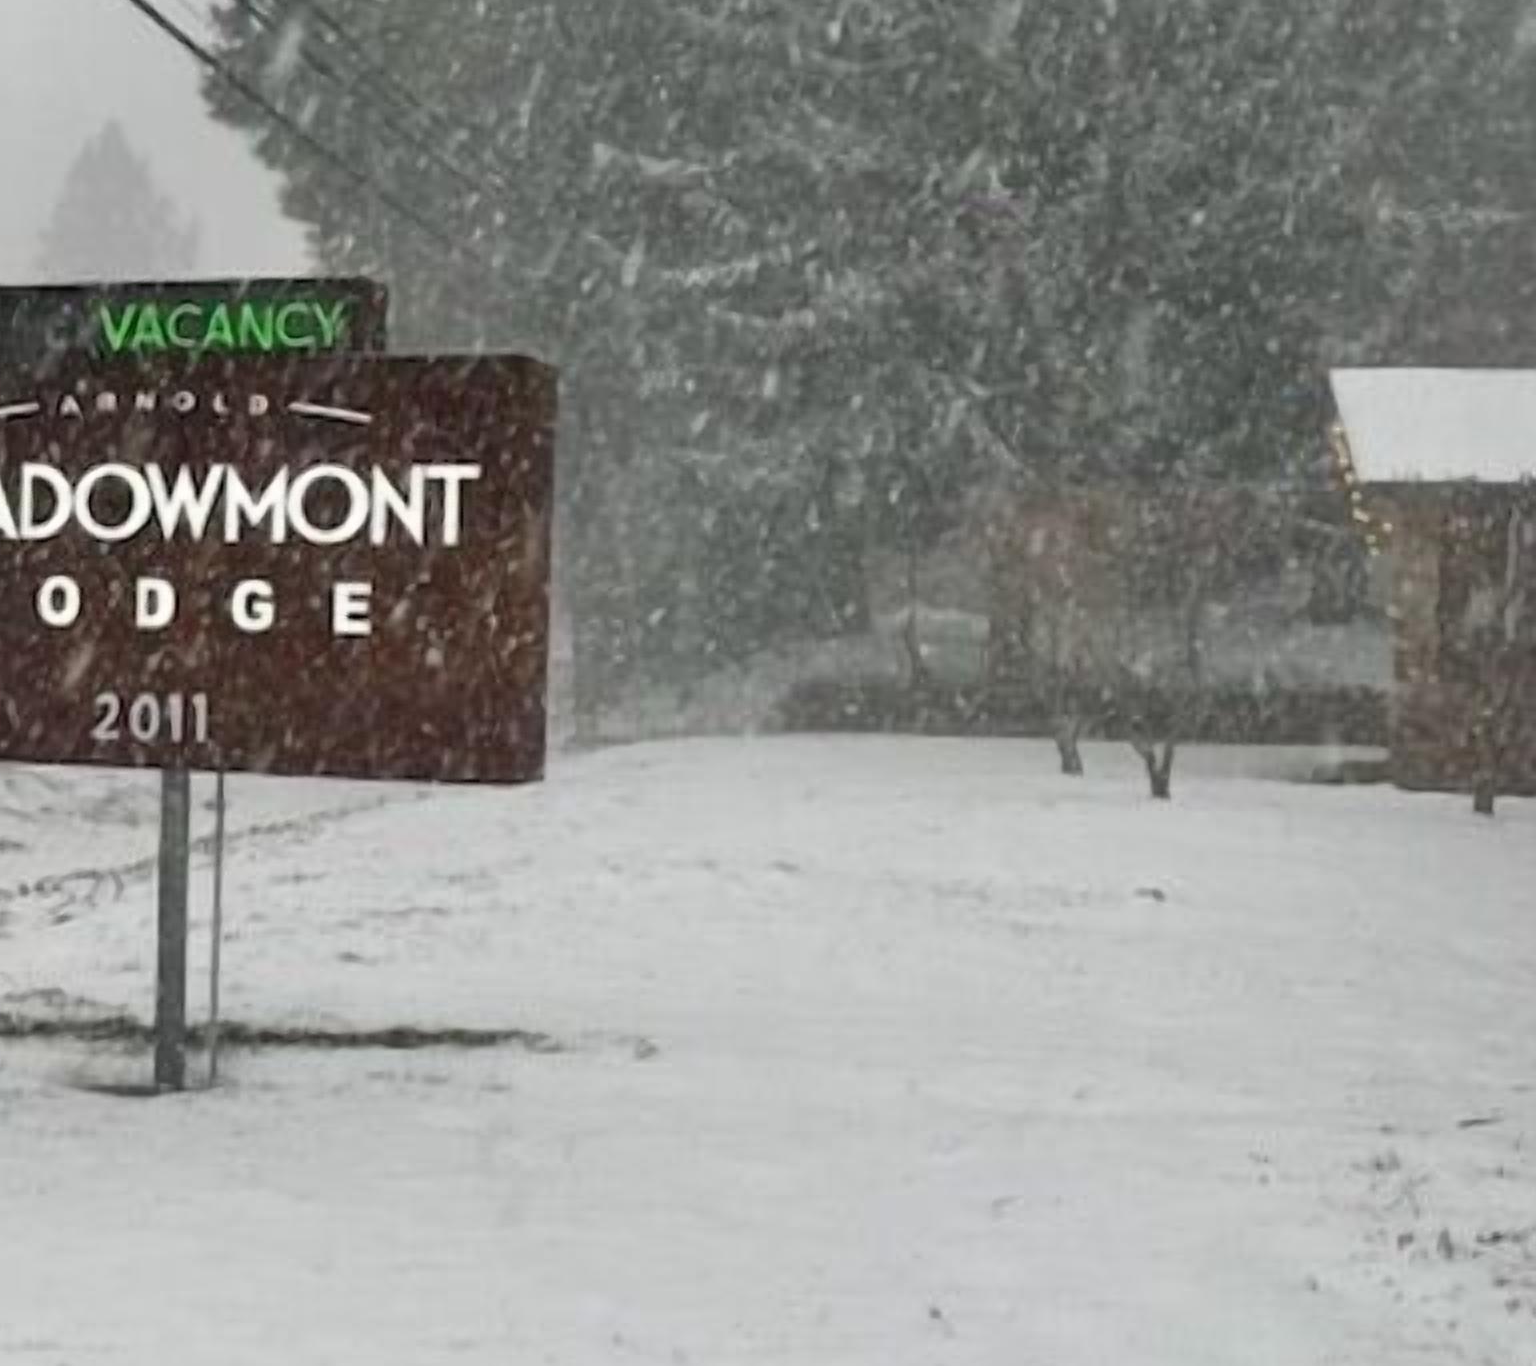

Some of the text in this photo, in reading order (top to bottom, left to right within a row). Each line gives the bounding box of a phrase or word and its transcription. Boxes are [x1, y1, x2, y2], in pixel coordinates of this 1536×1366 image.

[100, 301, 345, 351] VACANCY
[60, 390, 270, 418] ARNOLD
[91, 693, 210, 743] 2011
